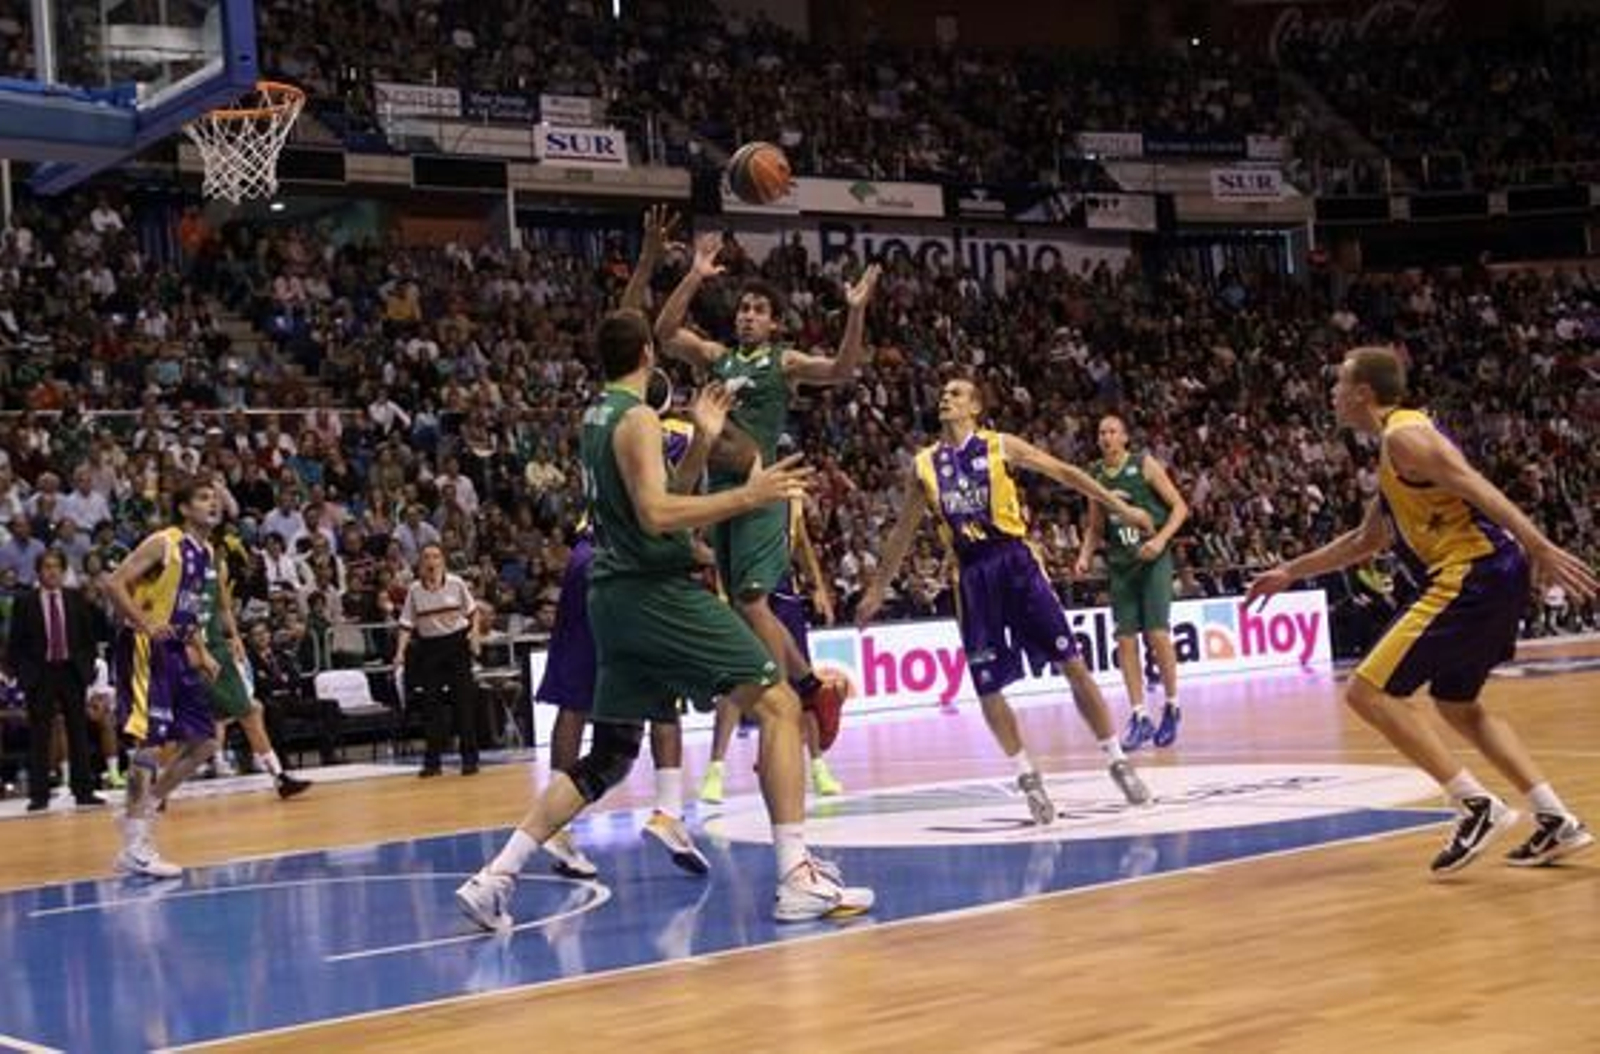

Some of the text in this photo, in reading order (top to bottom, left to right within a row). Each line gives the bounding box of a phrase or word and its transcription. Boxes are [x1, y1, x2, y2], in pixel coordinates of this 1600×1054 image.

[546, 133, 616, 155] SUR
[1218, 174, 1277, 191] SUR
[861, 636, 968, 706] hoy
[1238, 602, 1320, 667] hoy
